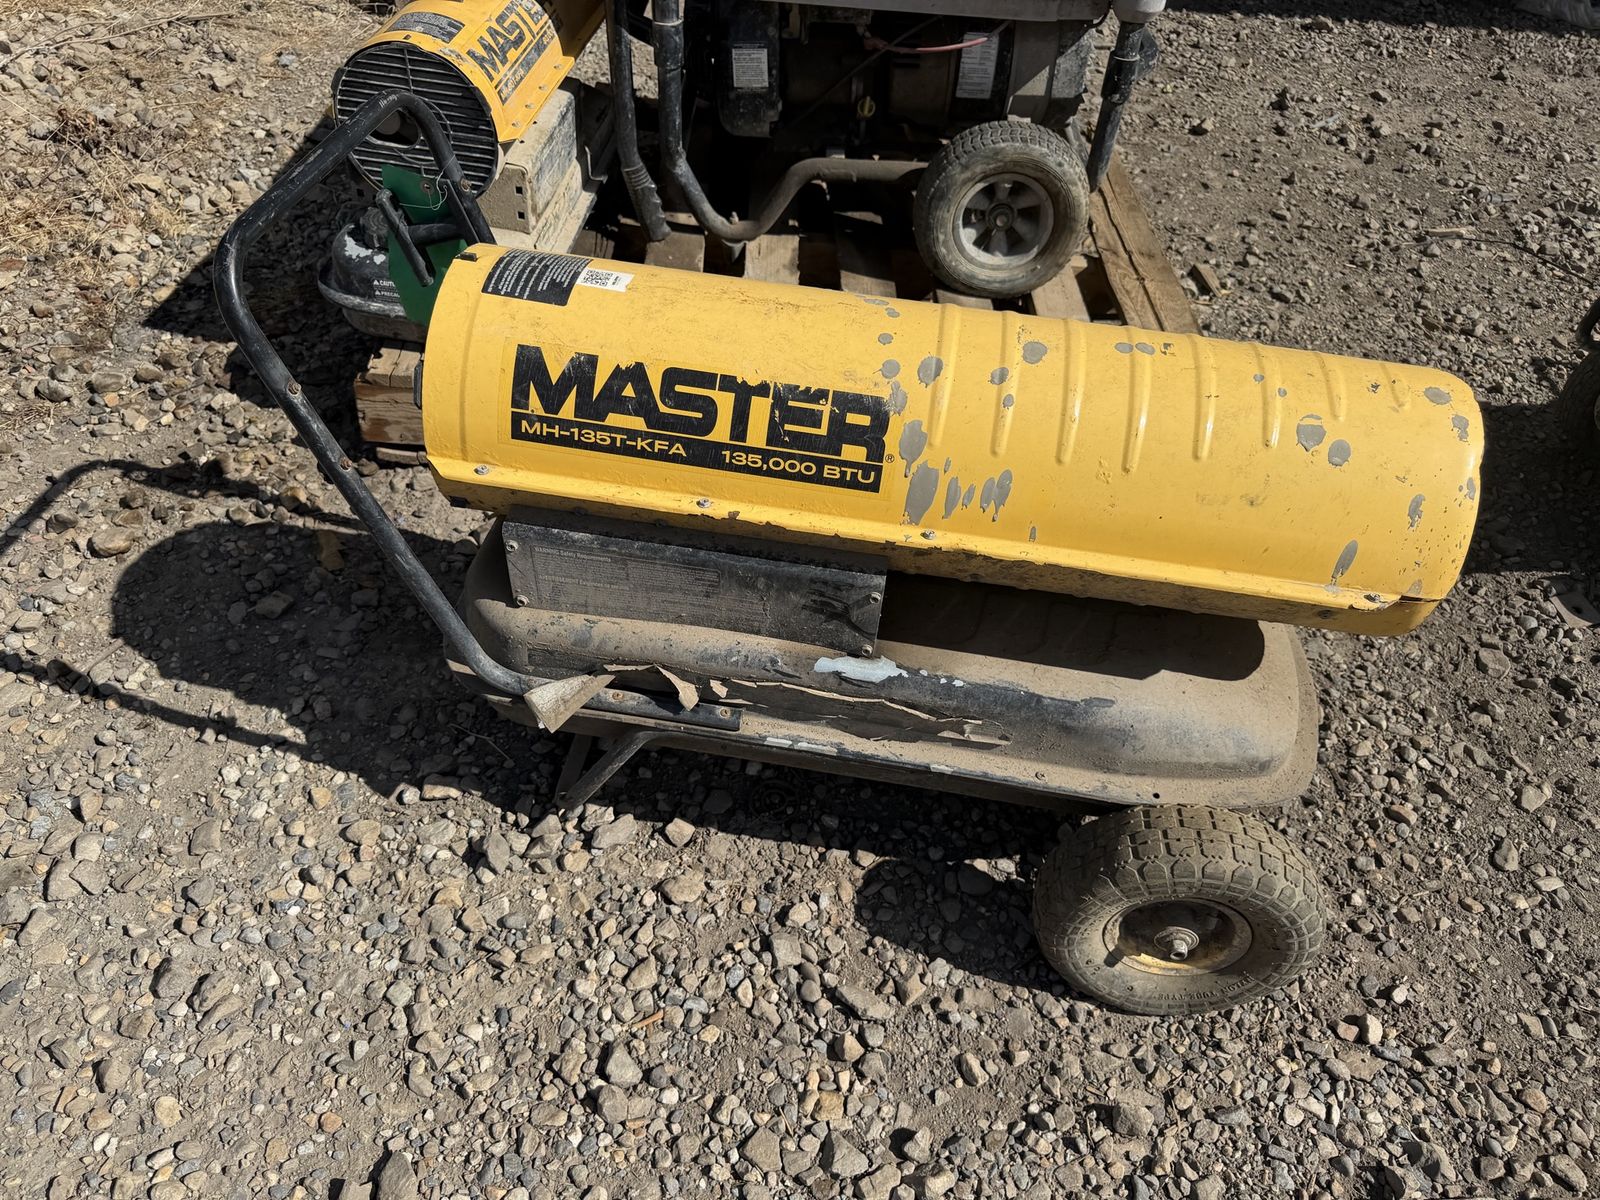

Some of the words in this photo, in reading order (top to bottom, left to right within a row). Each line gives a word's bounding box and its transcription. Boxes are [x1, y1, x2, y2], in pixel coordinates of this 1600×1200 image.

[511, 343, 891, 463] MASTER
[521, 419, 687, 457] MH-135T-KFA
[721, 450, 817, 477] 135,000
[823, 464, 875, 484] BTU
